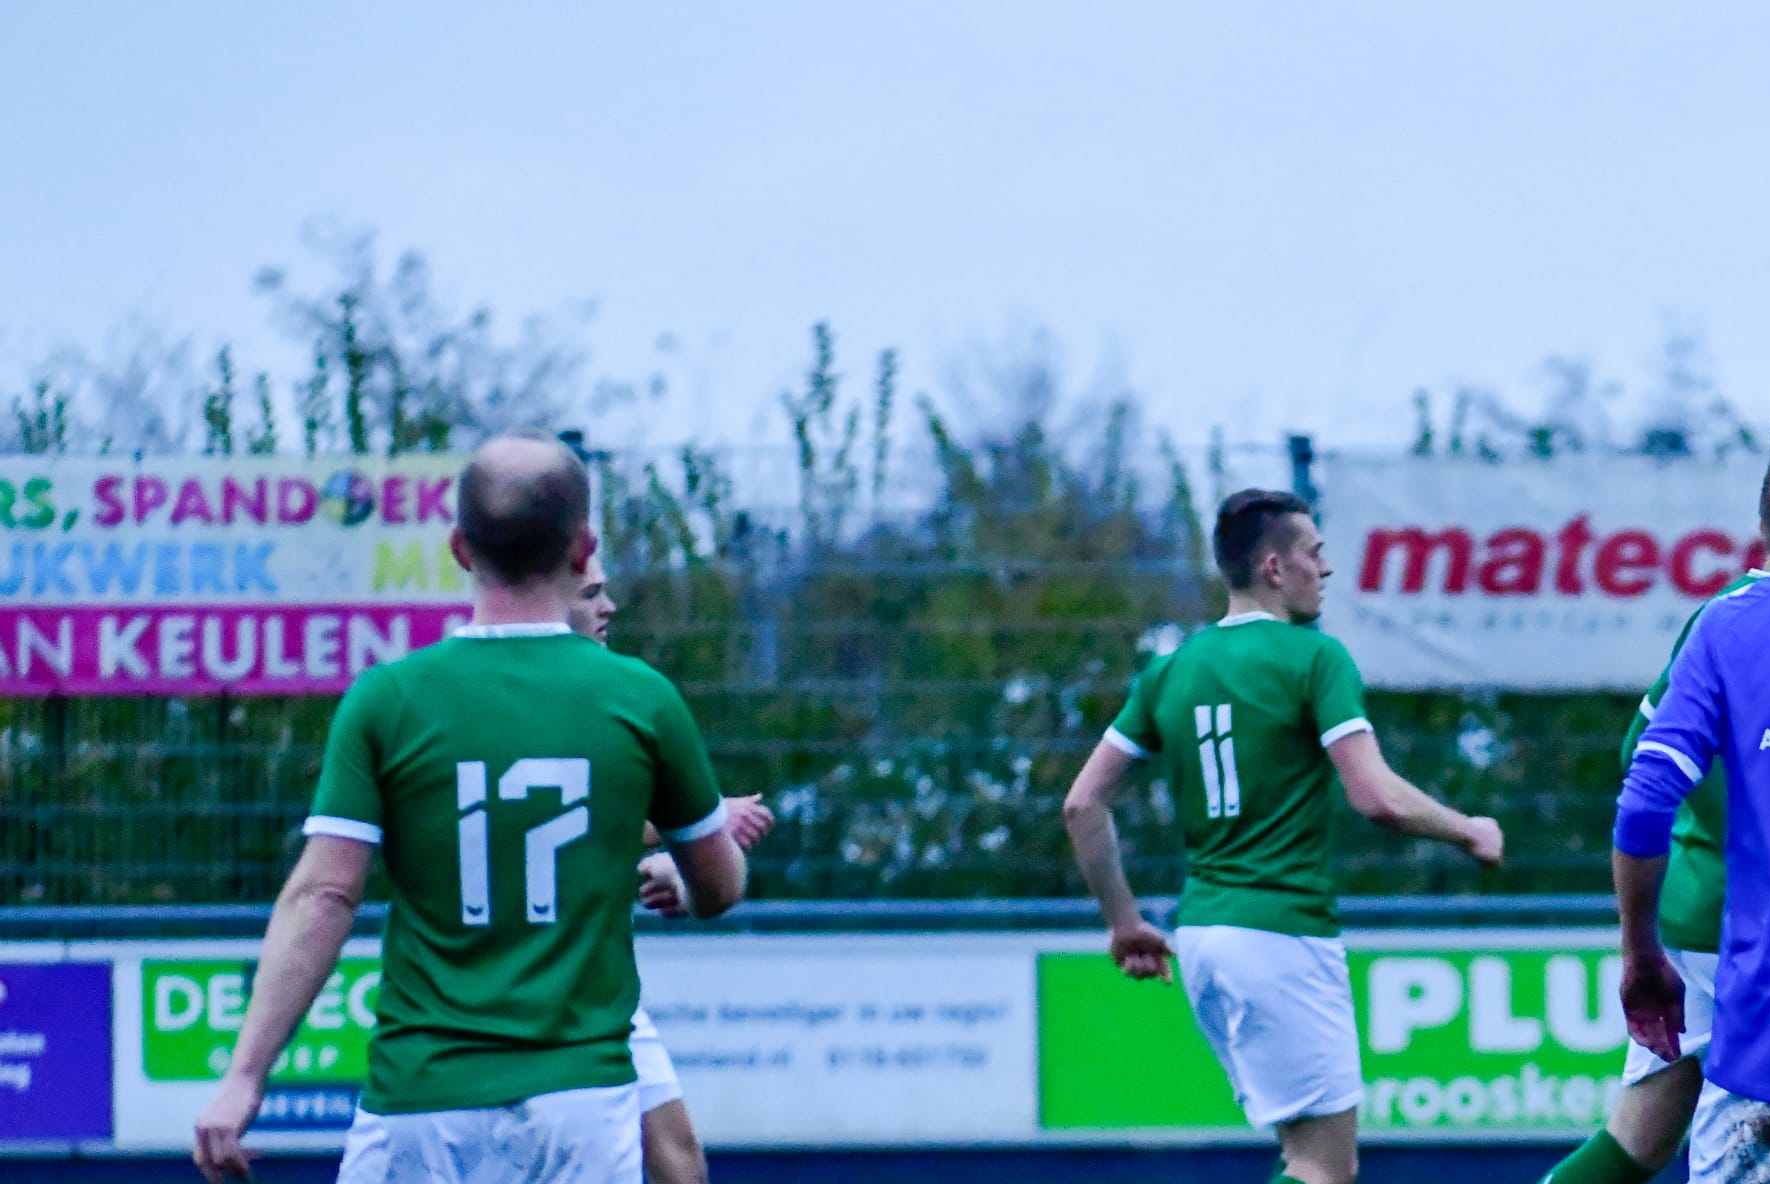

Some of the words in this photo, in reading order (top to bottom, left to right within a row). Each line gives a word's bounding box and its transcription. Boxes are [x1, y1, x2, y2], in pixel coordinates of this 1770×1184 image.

[100, 614, 411, 682] KEULEN
[1195, 704, 1240, 817] 11
[456, 758, 590, 924] 17
